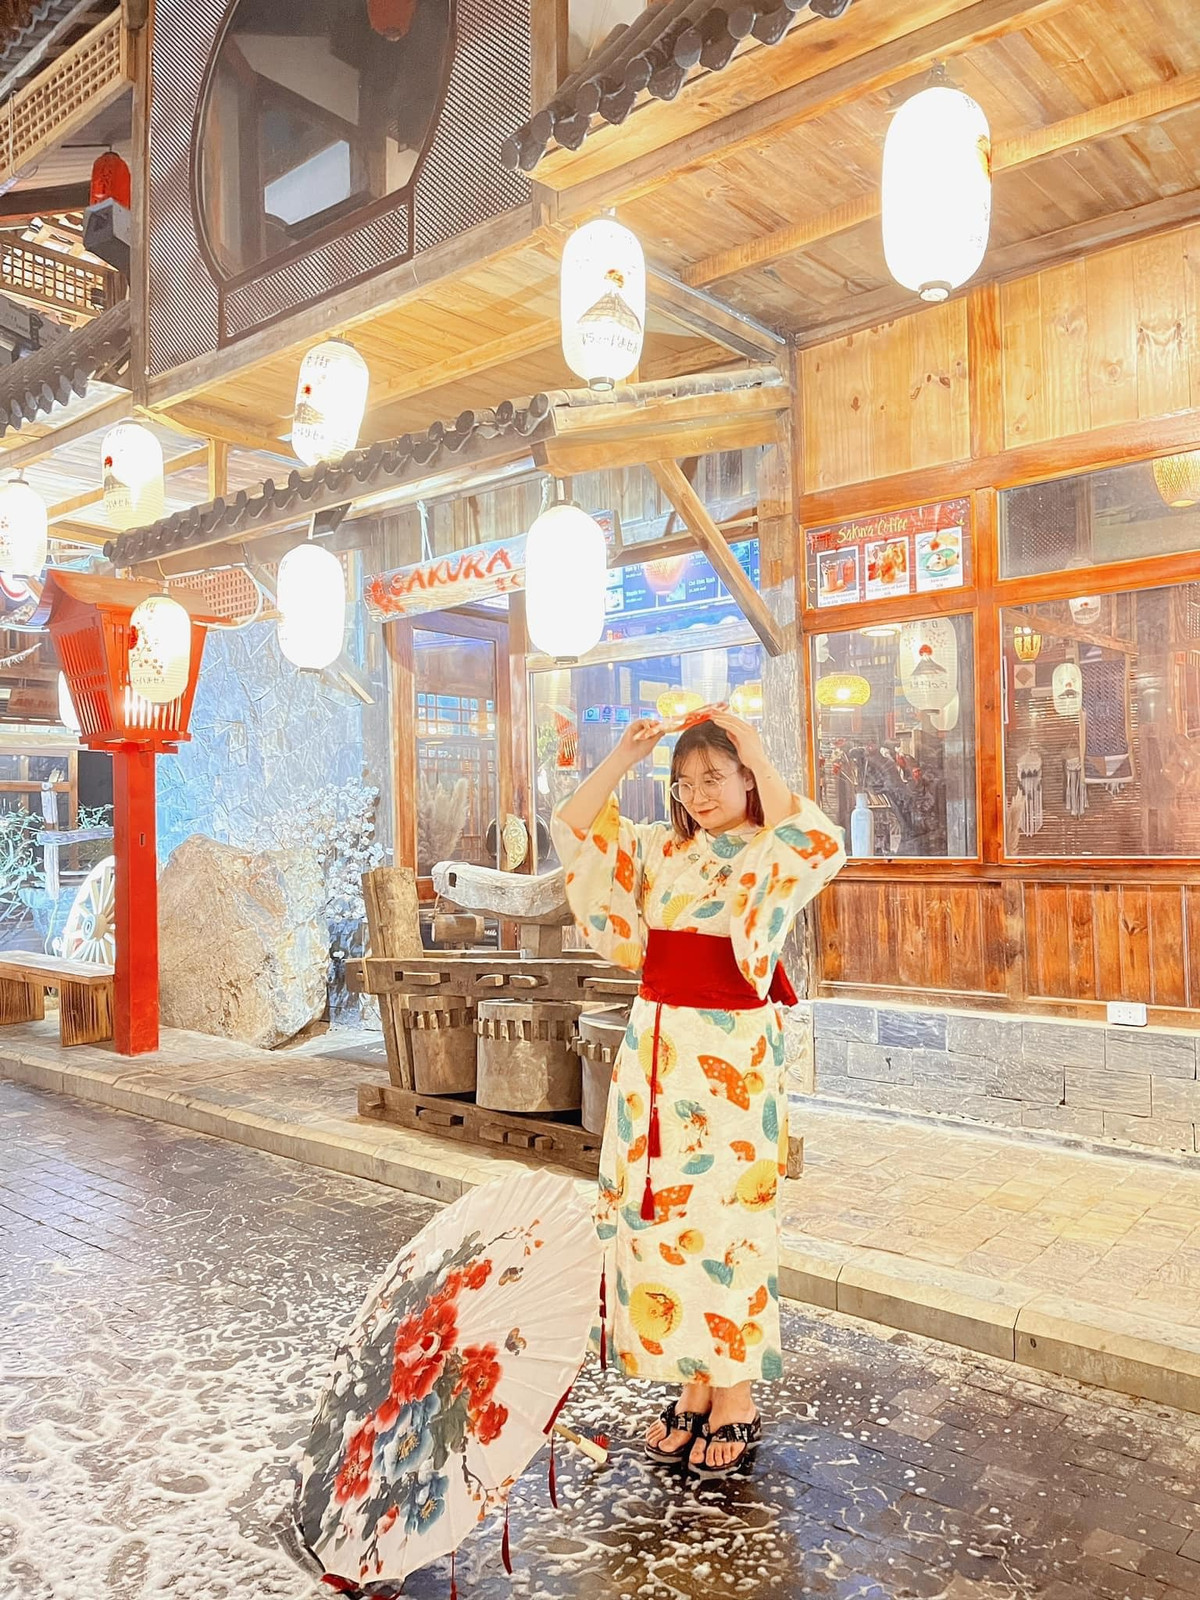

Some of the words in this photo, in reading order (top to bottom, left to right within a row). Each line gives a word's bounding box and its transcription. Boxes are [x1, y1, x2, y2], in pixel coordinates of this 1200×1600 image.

[837, 523, 875, 544] Sakura
[877, 517, 909, 537] Coffee
[389, 548, 512, 596] SAKURA
